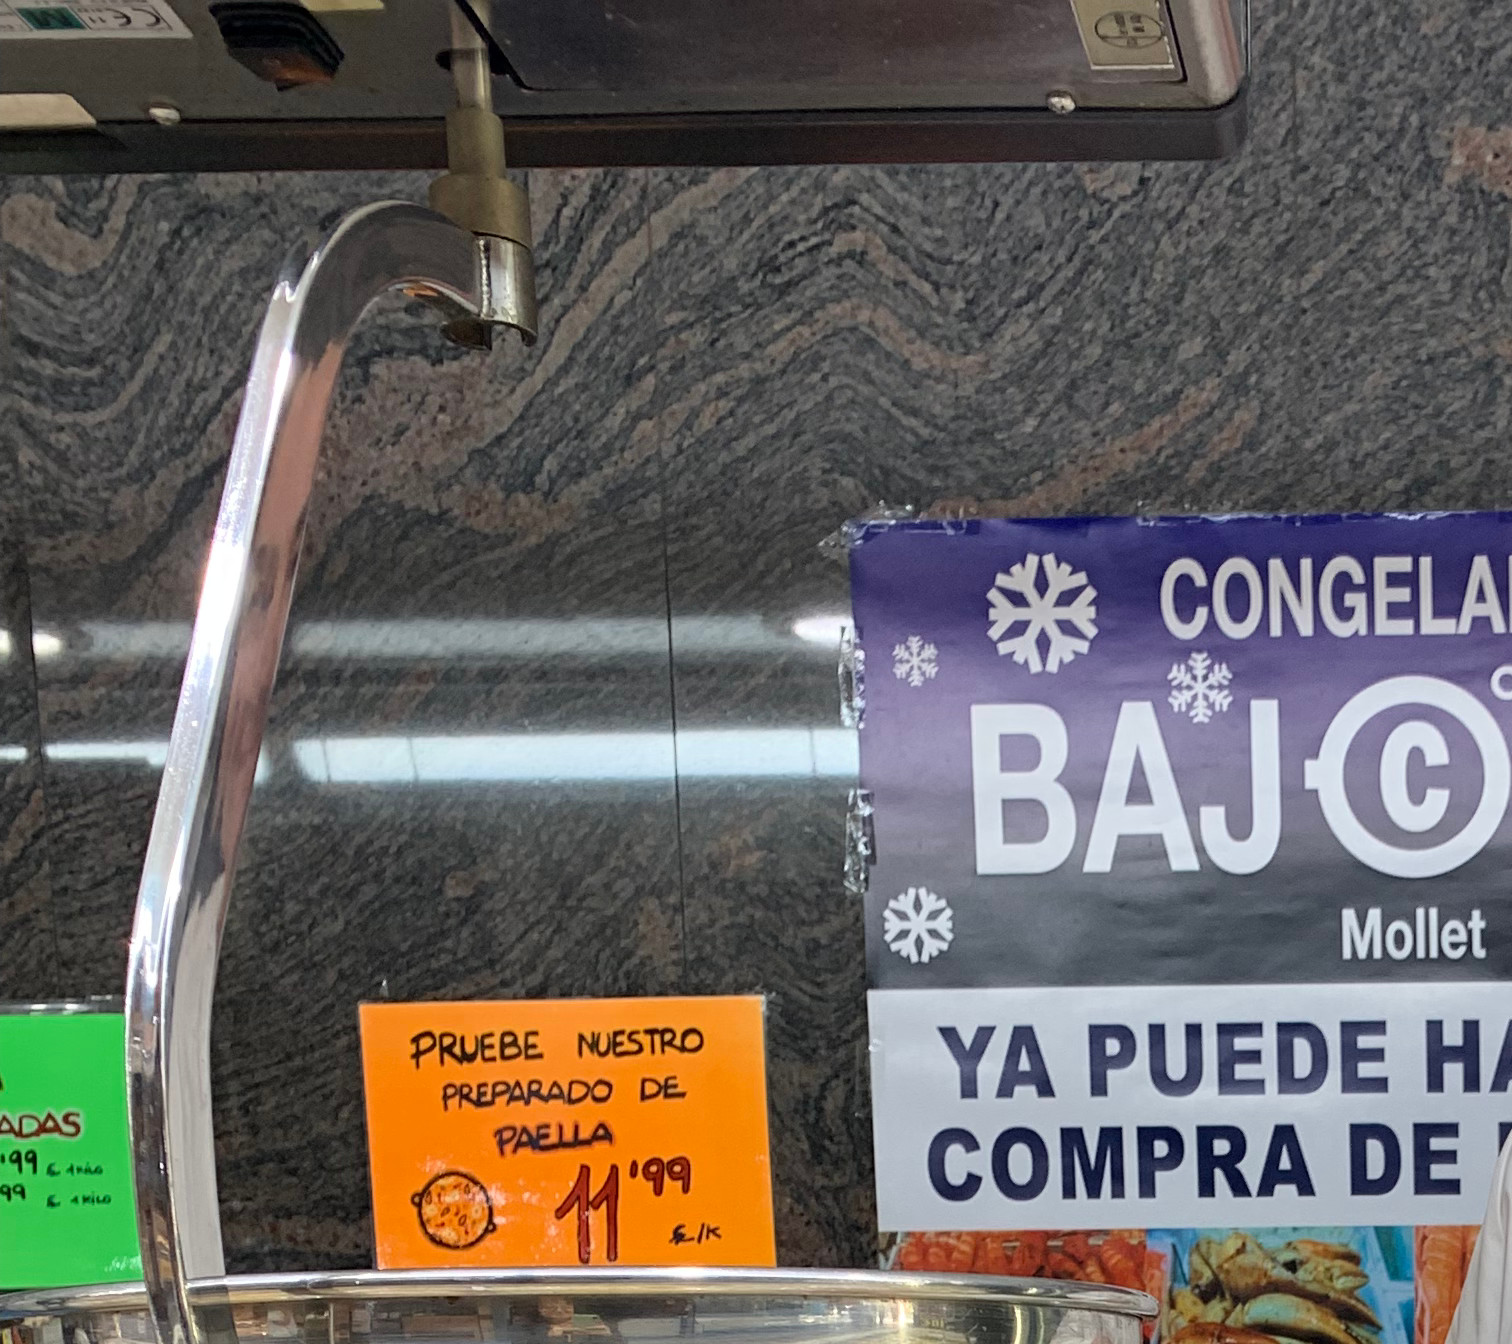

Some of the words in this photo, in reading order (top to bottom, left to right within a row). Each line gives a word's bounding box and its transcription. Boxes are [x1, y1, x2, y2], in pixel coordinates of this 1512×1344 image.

[1341, 907, 1487, 960] Mollet
[410, 1030, 544, 1070] PRUEBE
[577, 1027, 705, 1059] NUESTRO
[938, 1024, 1056, 1099] YA
[1088, 1018, 1389, 1097] PUEDE
[442, 1078, 613, 1112] PREPARADO
[639, 1075, 687, 1103] DE
[493, 1120, 614, 1157] PAELLA
[926, 1121, 1316, 1201] COMPRA
[1350, 1120, 1462, 1197] DE
